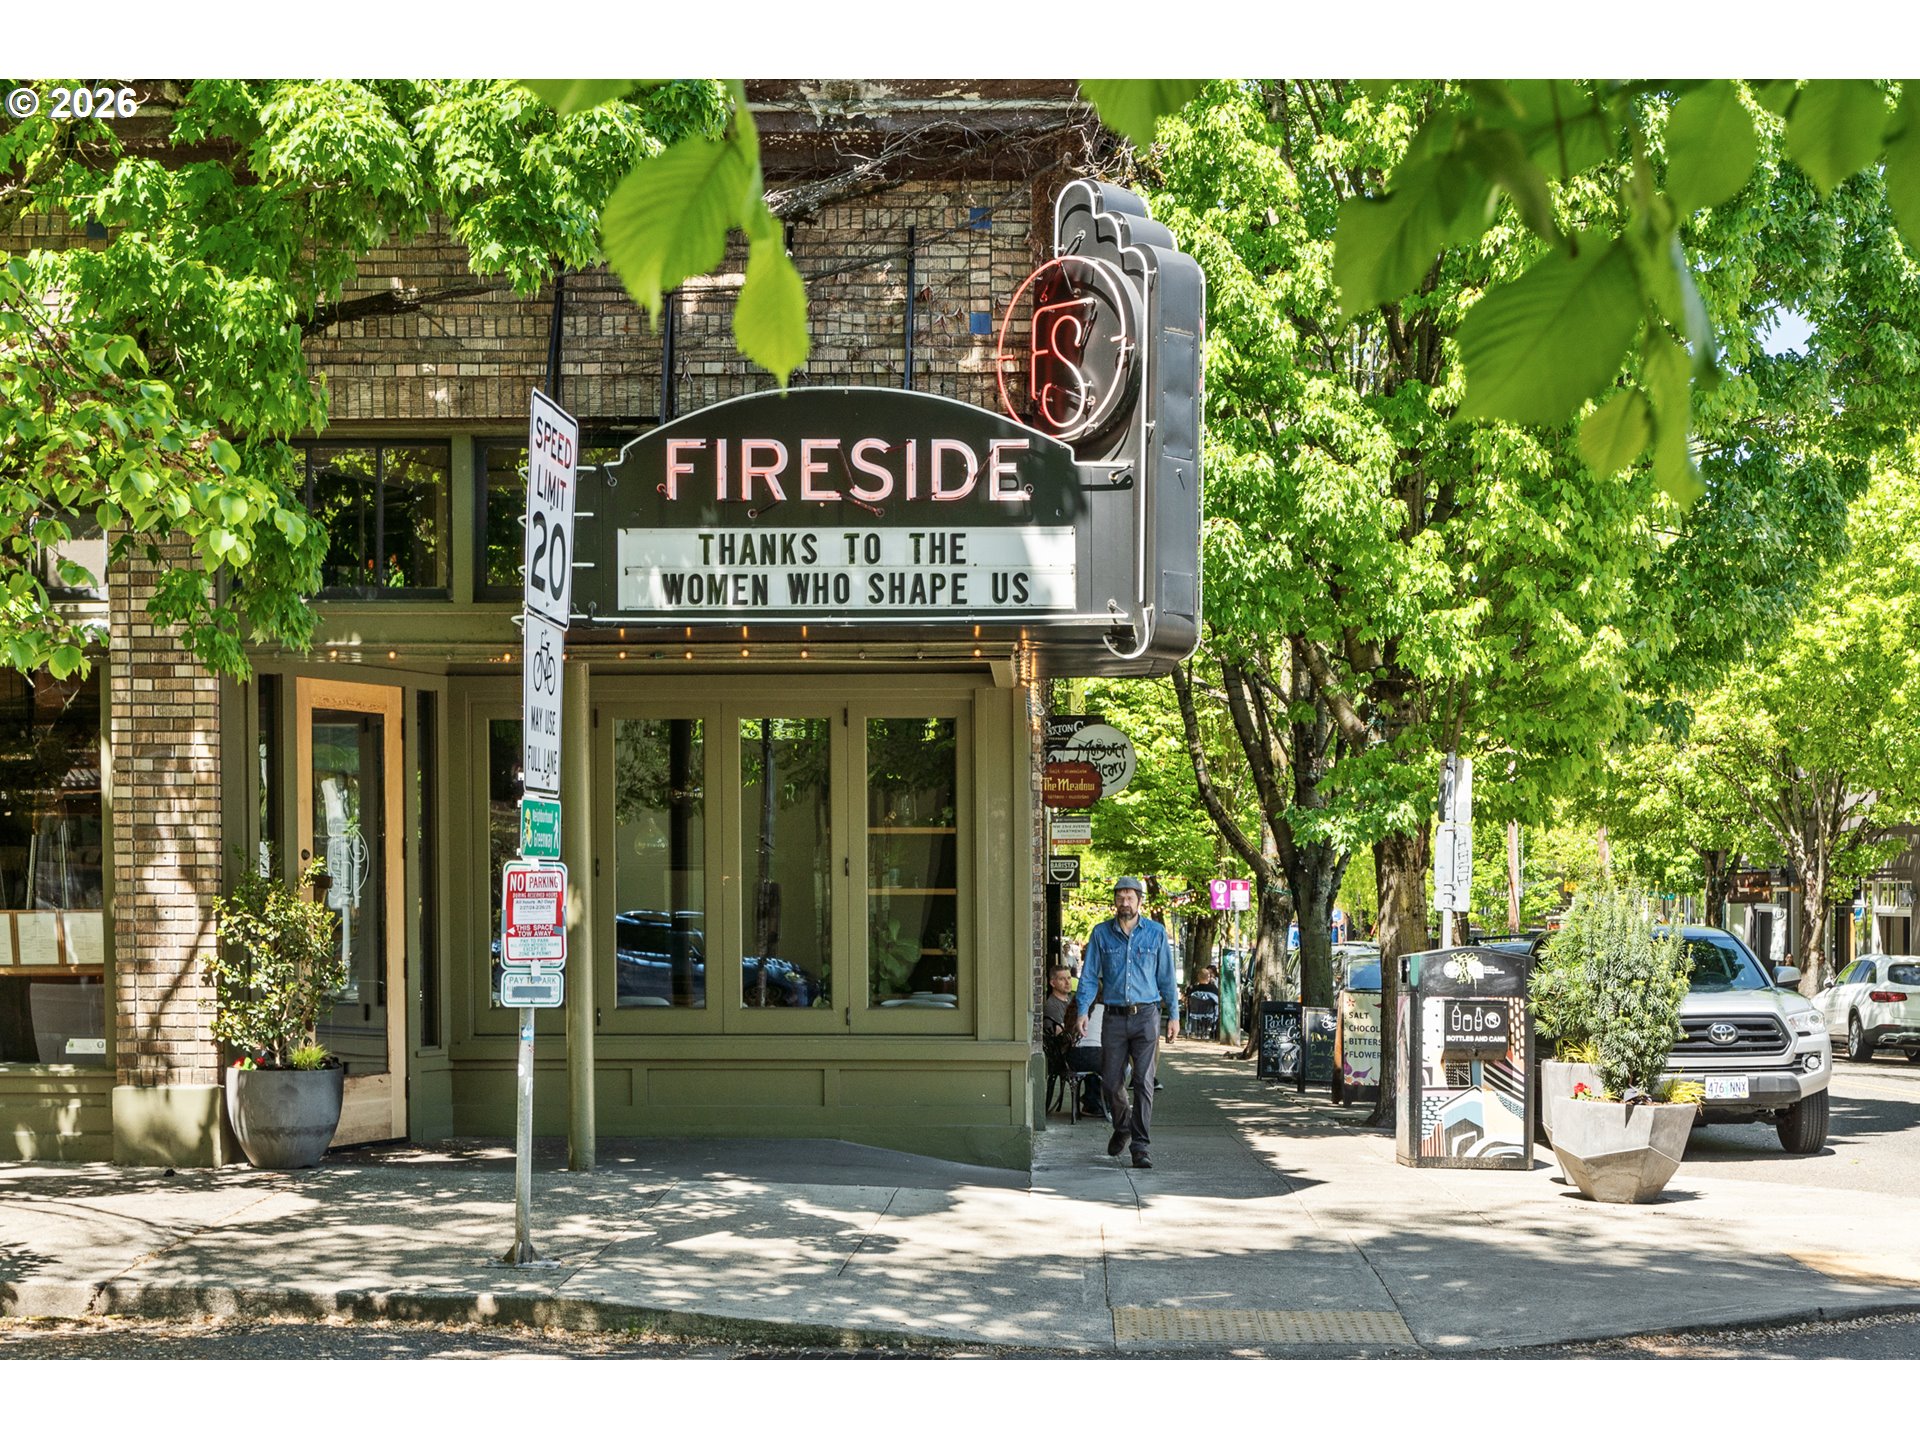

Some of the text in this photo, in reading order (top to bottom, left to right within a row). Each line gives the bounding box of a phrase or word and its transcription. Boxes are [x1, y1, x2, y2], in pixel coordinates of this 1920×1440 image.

[535, 416, 572, 469] SPEED
[666, 438, 1031, 500] FIRESIDE
[536, 464, 566, 511] LIMIT
[531, 511, 566, 601] 20
[699, 532, 967, 566] THANKS TO THE
[661, 572, 1029, 605] WOMEN WHO SHAPE US
[530, 705, 556, 736] MAY USE
[528, 744, 557, 775] FULL LANE
[1042, 777, 1095, 791] The Meadow
[510, 873, 559, 892] NO PARKING
[1349, 1051, 1381, 1059] FLOWER
[1708, 1081, 1746, 1093] 476 NNX
